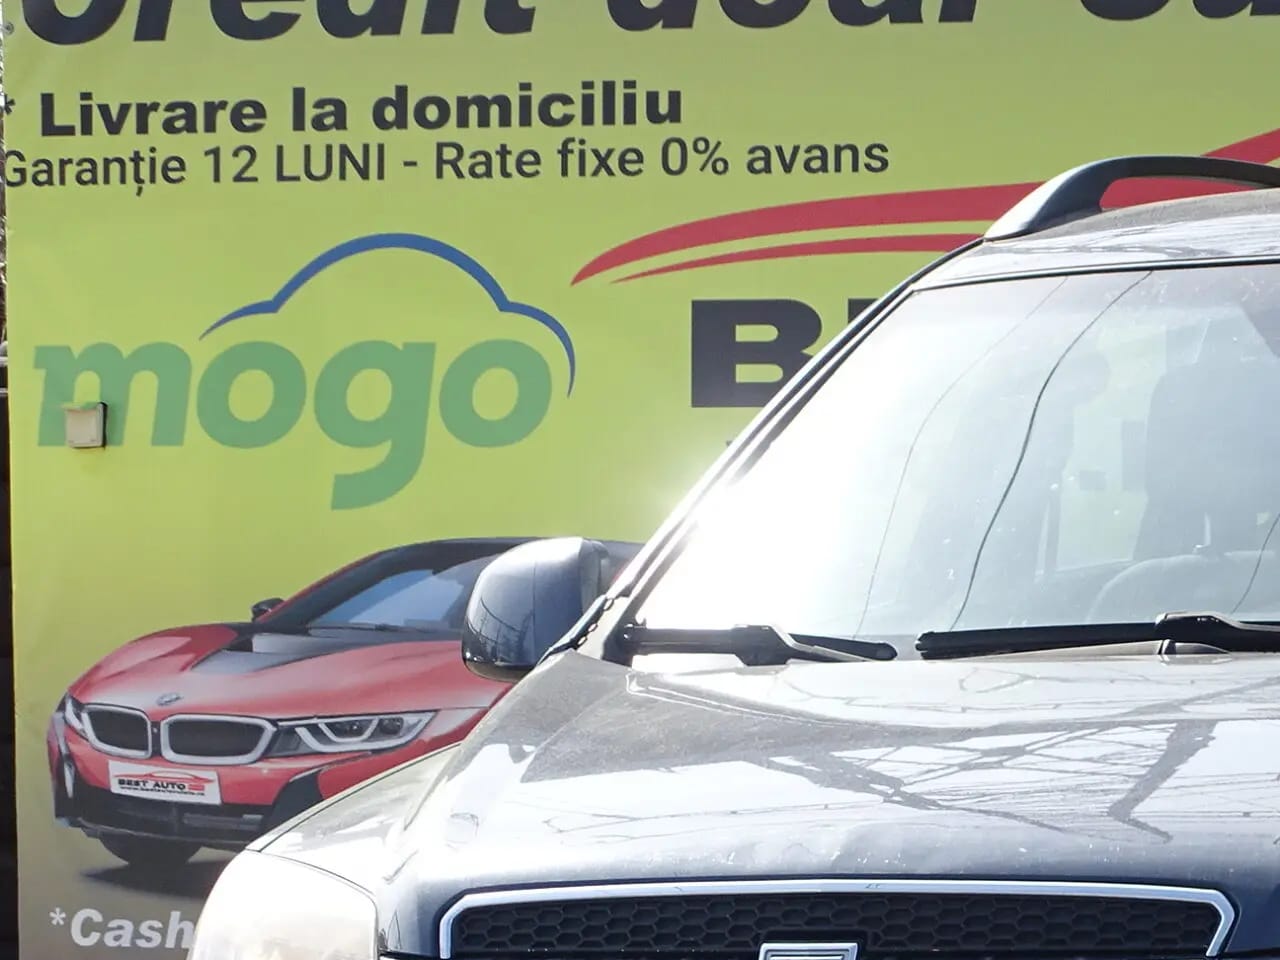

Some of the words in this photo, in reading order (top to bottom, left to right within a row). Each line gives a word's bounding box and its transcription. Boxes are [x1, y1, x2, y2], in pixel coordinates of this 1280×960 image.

[40, 92, 267, 136] Livrare
[292, 87, 348, 132] la
[372, 80, 682, 130] domiciliu
[204, 145, 259, 184] 12
[276, 142, 385, 182] LUNI
[436, 141, 541, 179] Rate
[557, 137, 644, 177] fixe
[661, 137, 729, 176] 0%
[746, 142, 889, 174] avans
[34, 339, 553, 510] mogo
